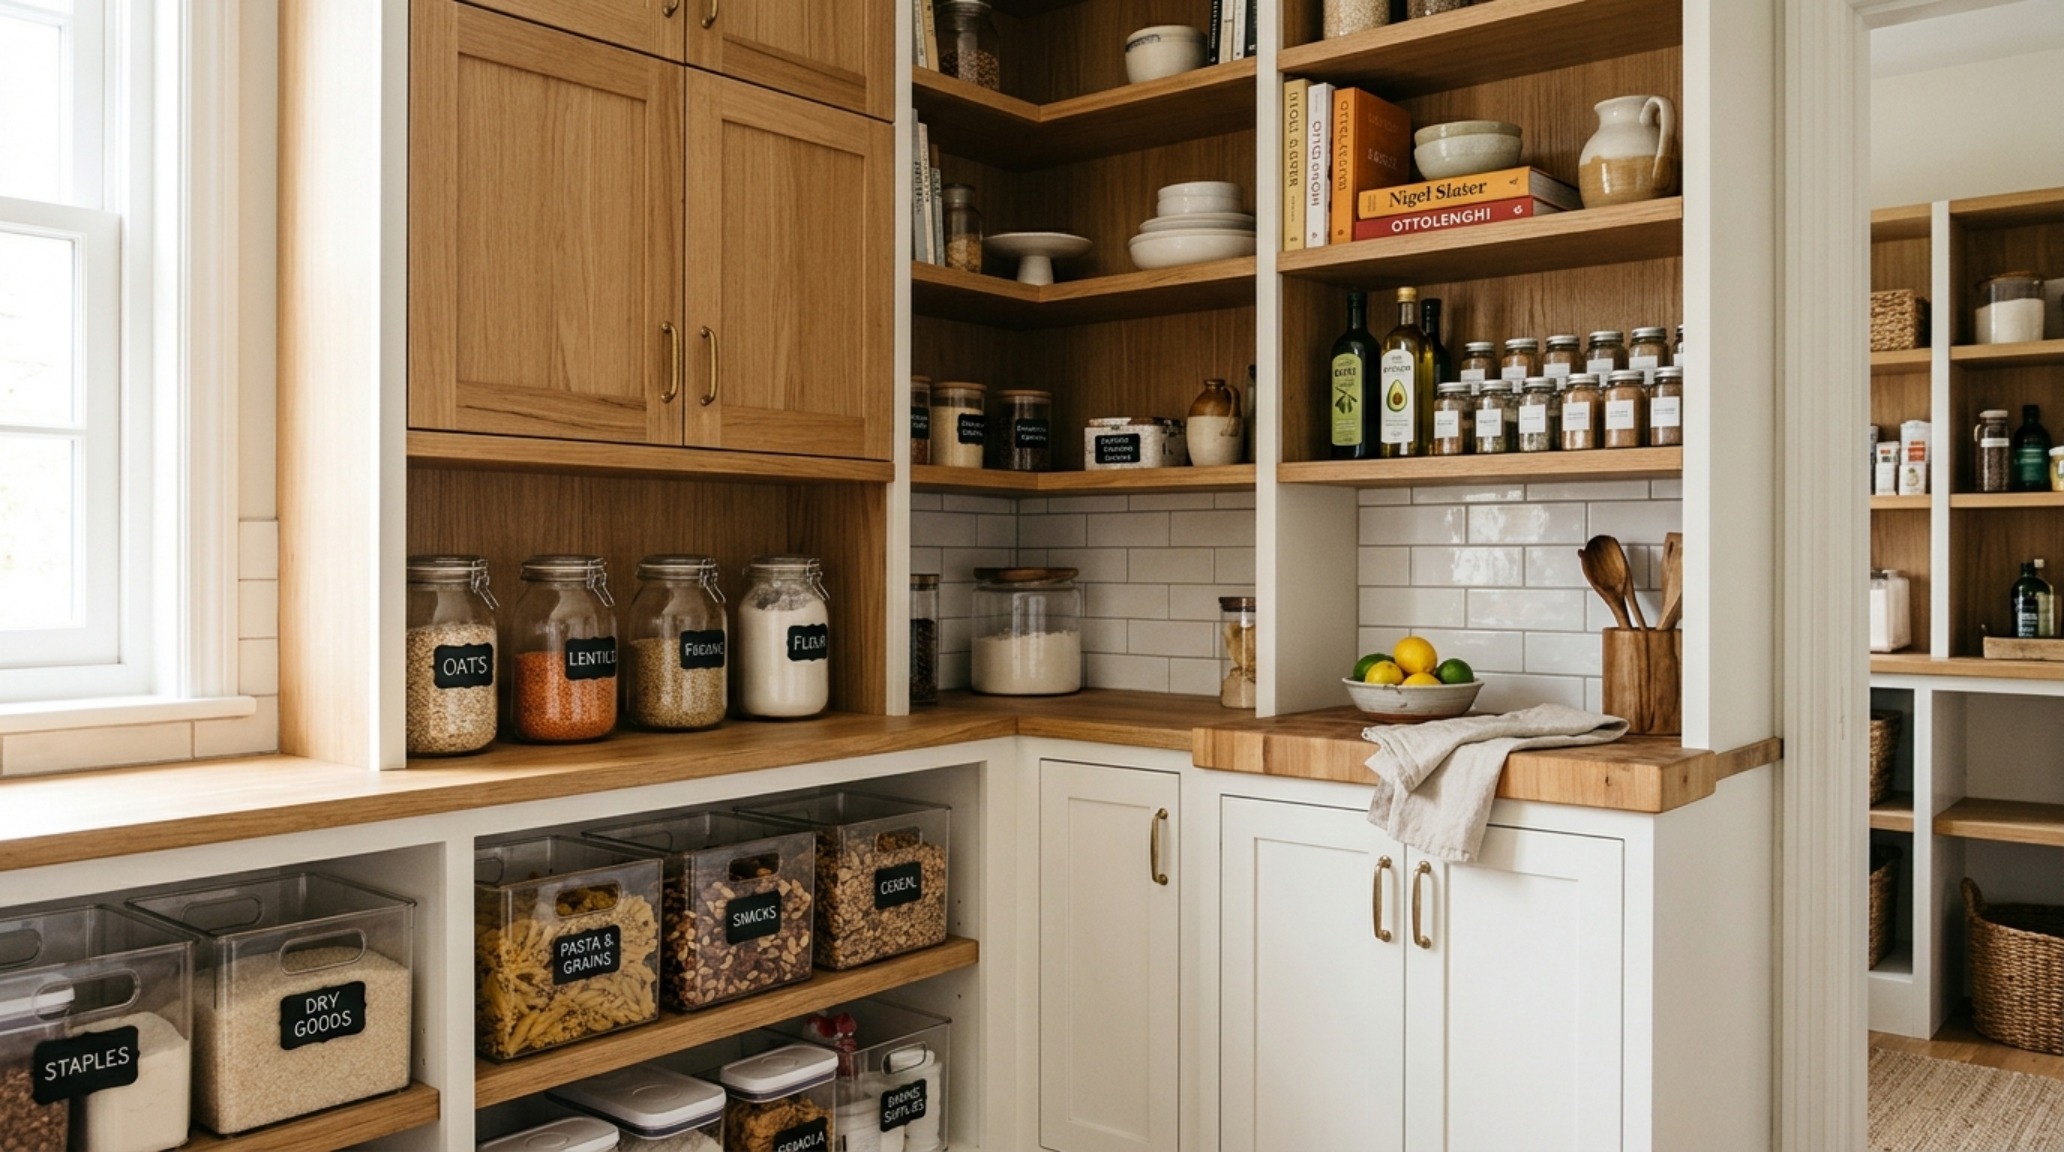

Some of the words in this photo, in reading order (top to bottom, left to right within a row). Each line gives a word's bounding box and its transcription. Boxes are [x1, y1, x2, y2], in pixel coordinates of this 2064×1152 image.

[1389, 185, 1431, 208] Nigel
[1391, 207, 1491, 232] OTTOLENGHI
[443, 655, 488, 676] OATS
[733, 905, 777, 928] SNACKS
[560, 936, 601, 957] PASTA
[604, 932, 615, 948] &
[563, 951, 612, 975] GRAINS
[305, 991, 340, 1015] DRY
[294, 1009, 352, 1037] GOODS
[44, 1046, 130, 1081] STAPLES
